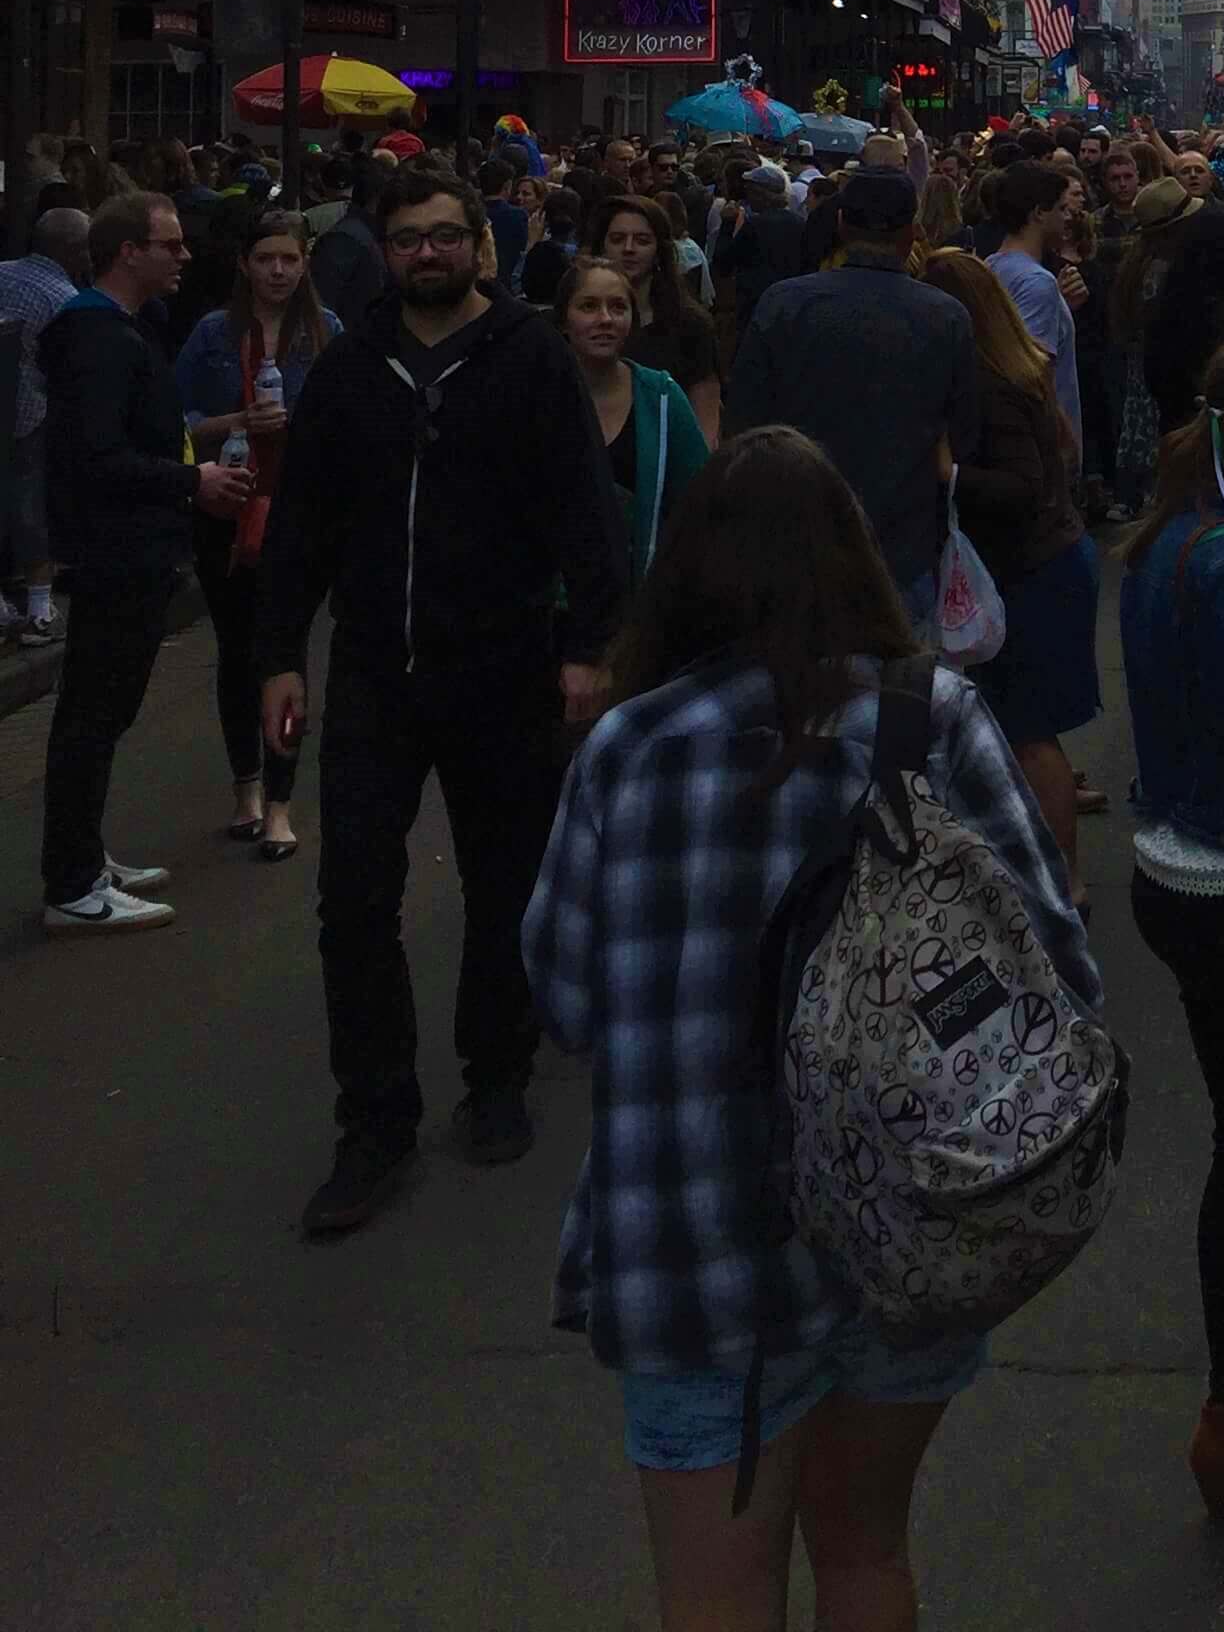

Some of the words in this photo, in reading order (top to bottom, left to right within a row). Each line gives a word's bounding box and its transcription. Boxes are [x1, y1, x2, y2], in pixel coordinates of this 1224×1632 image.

[327, 6, 386, 28] CUISINE
[578, 30, 632, 55] Krazy
[636, 33, 707, 55] Korner
